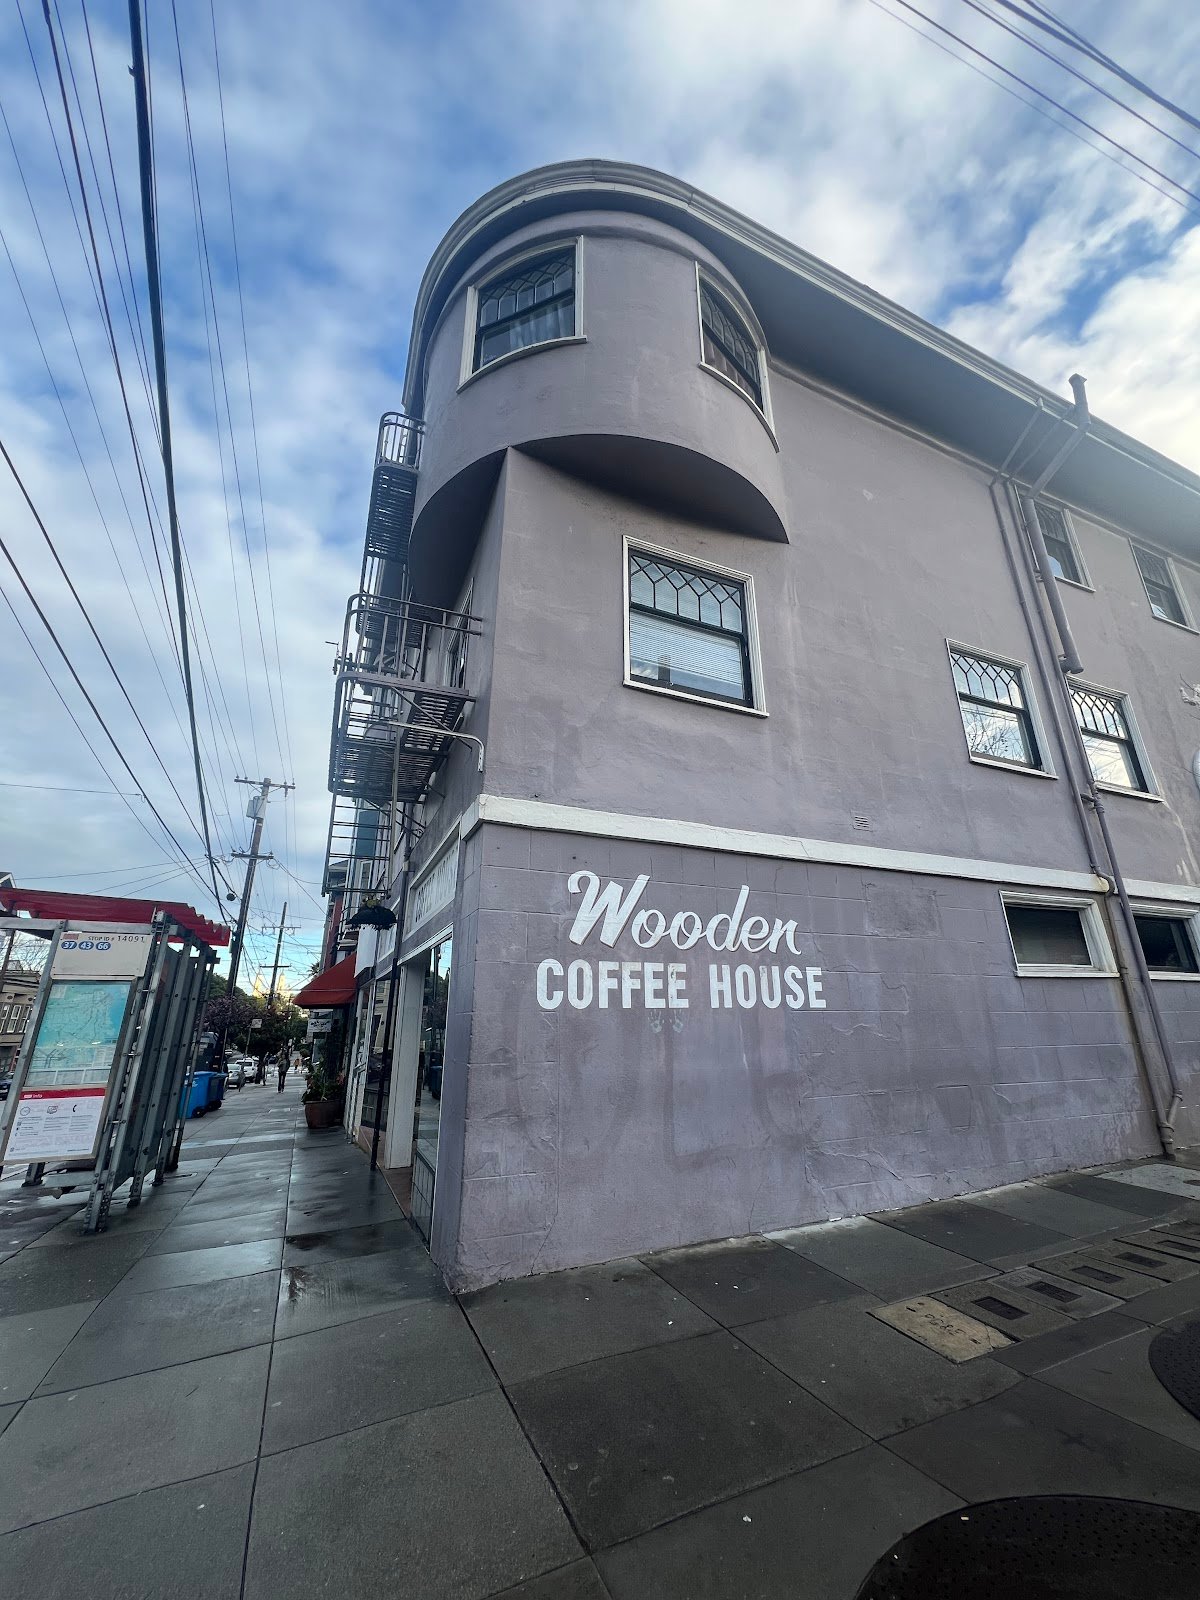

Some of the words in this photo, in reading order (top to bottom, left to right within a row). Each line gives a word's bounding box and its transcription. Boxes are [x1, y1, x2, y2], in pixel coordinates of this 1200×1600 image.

[568, 870, 801, 955] Wooden
[63, 941, 75, 949] 37
[80, 941, 92, 950] 43
[97, 942, 109, 950] 66
[117, 935, 145, 943] 14091
[536, 958, 689, 1010] COFFEE
[708, 963, 827, 1009] HOUSE
